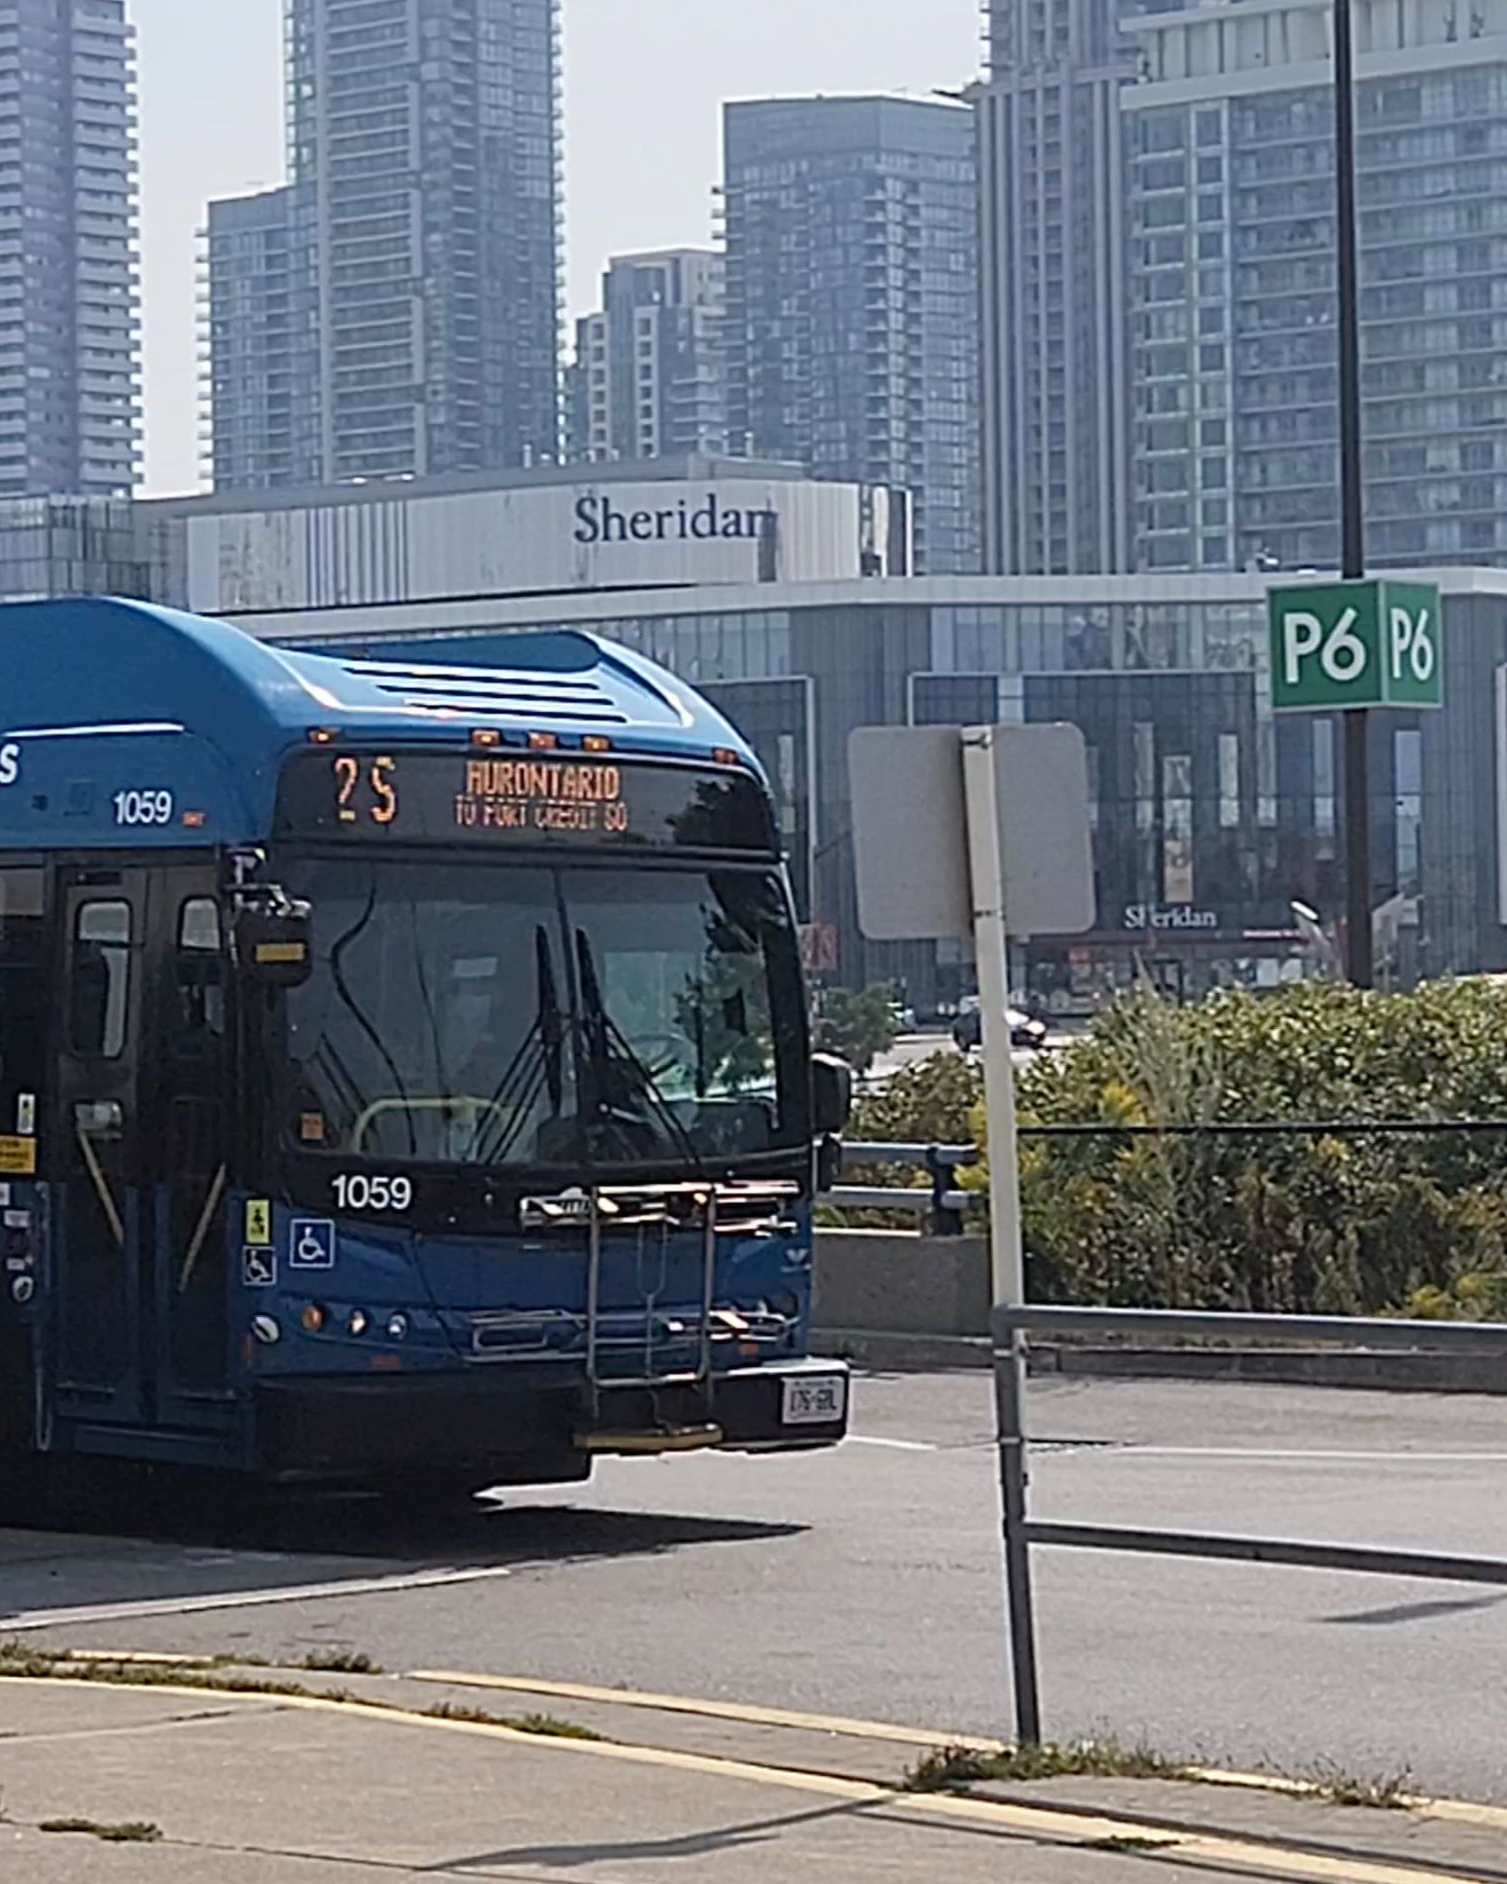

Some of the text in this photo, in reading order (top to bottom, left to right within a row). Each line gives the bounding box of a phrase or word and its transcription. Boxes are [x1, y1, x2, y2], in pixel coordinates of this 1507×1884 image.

[574, 492, 777, 543] Sheridan
[1284, 606, 1367, 683] P6
[1391, 607, 1434, 681] P6
[466, 759, 621, 800] HURONTARIO
[114, 790, 173, 824] 1059
[332, 1174, 412, 1210] 1059
